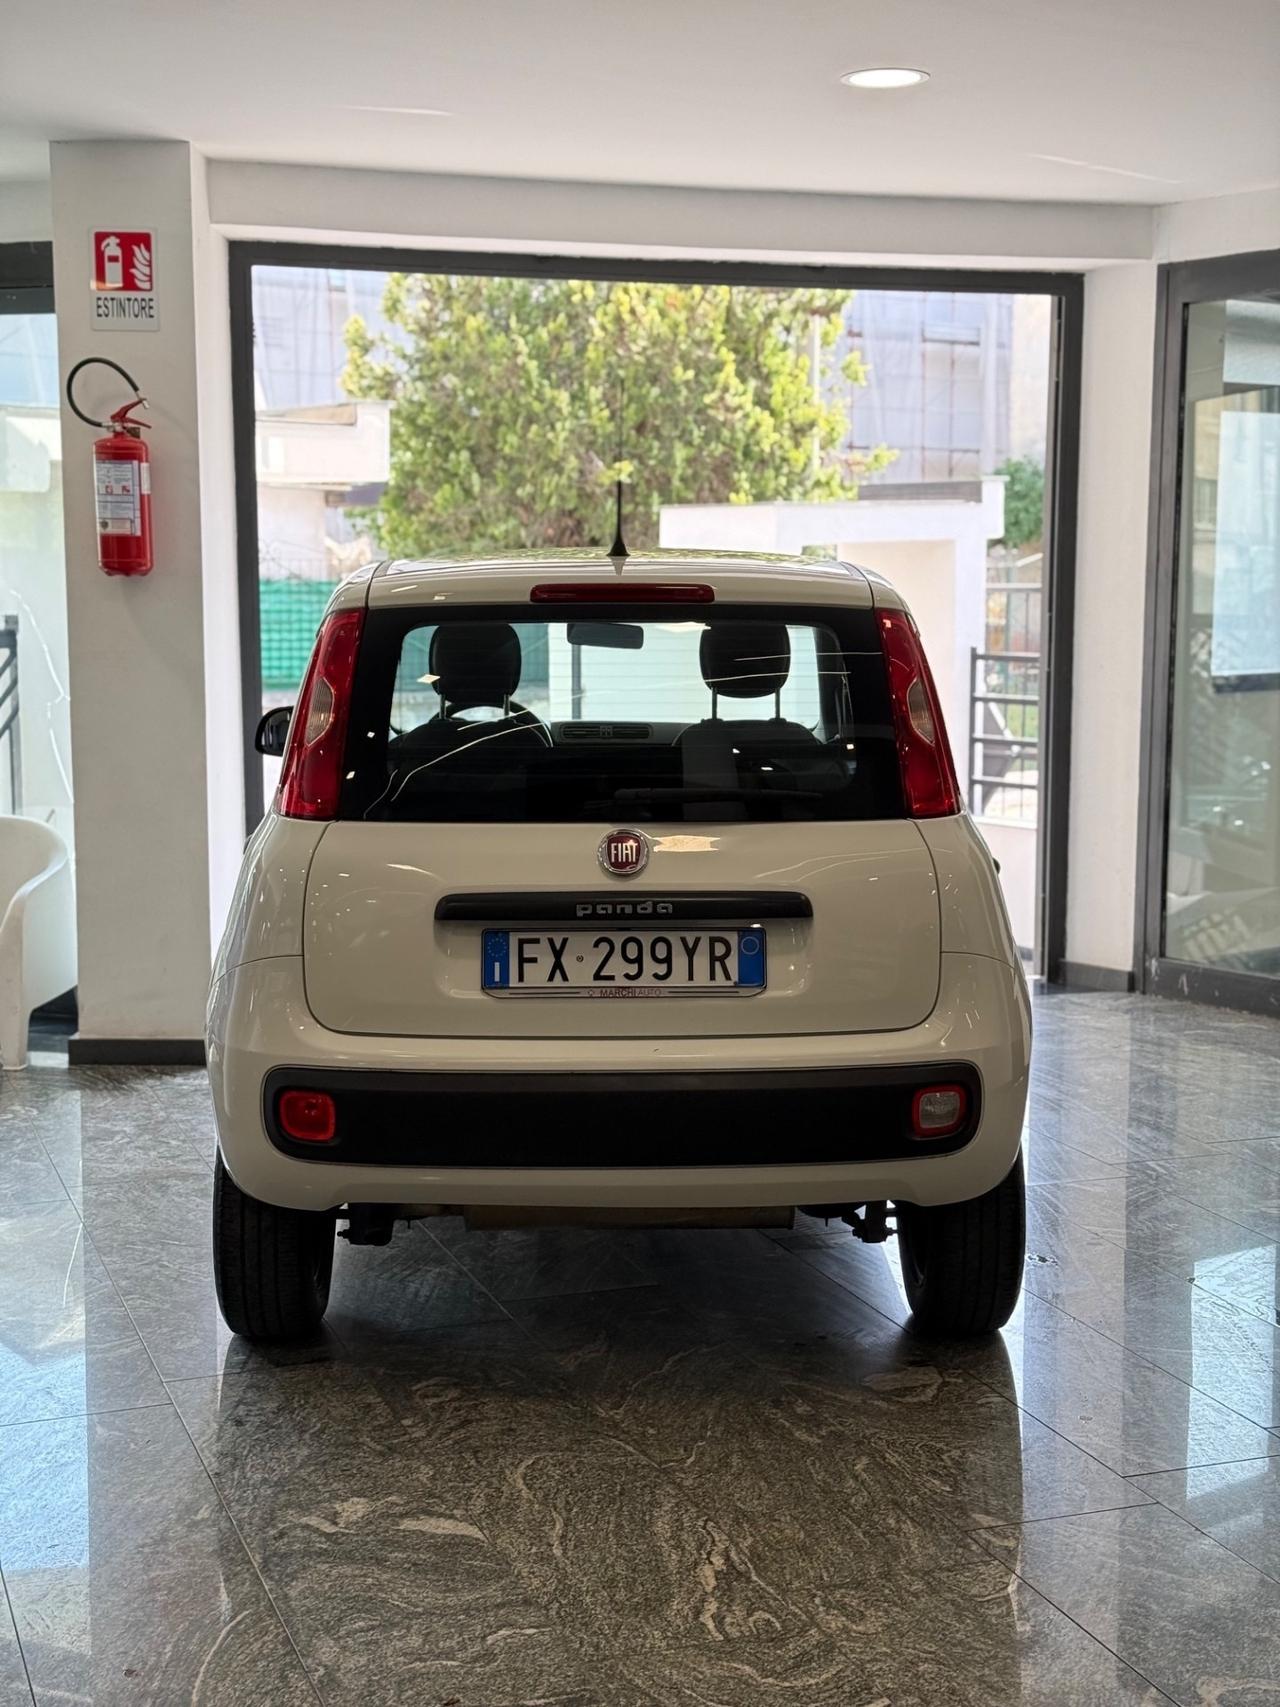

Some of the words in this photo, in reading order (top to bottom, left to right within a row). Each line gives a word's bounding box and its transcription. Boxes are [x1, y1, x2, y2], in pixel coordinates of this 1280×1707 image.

[96, 297, 154, 319] ESTINTORE
[611, 842, 638, 862] FIAT
[576, 901, 673, 917] panda
[517, 937, 569, 982] FX
[592, 936, 732, 981] 299YR
